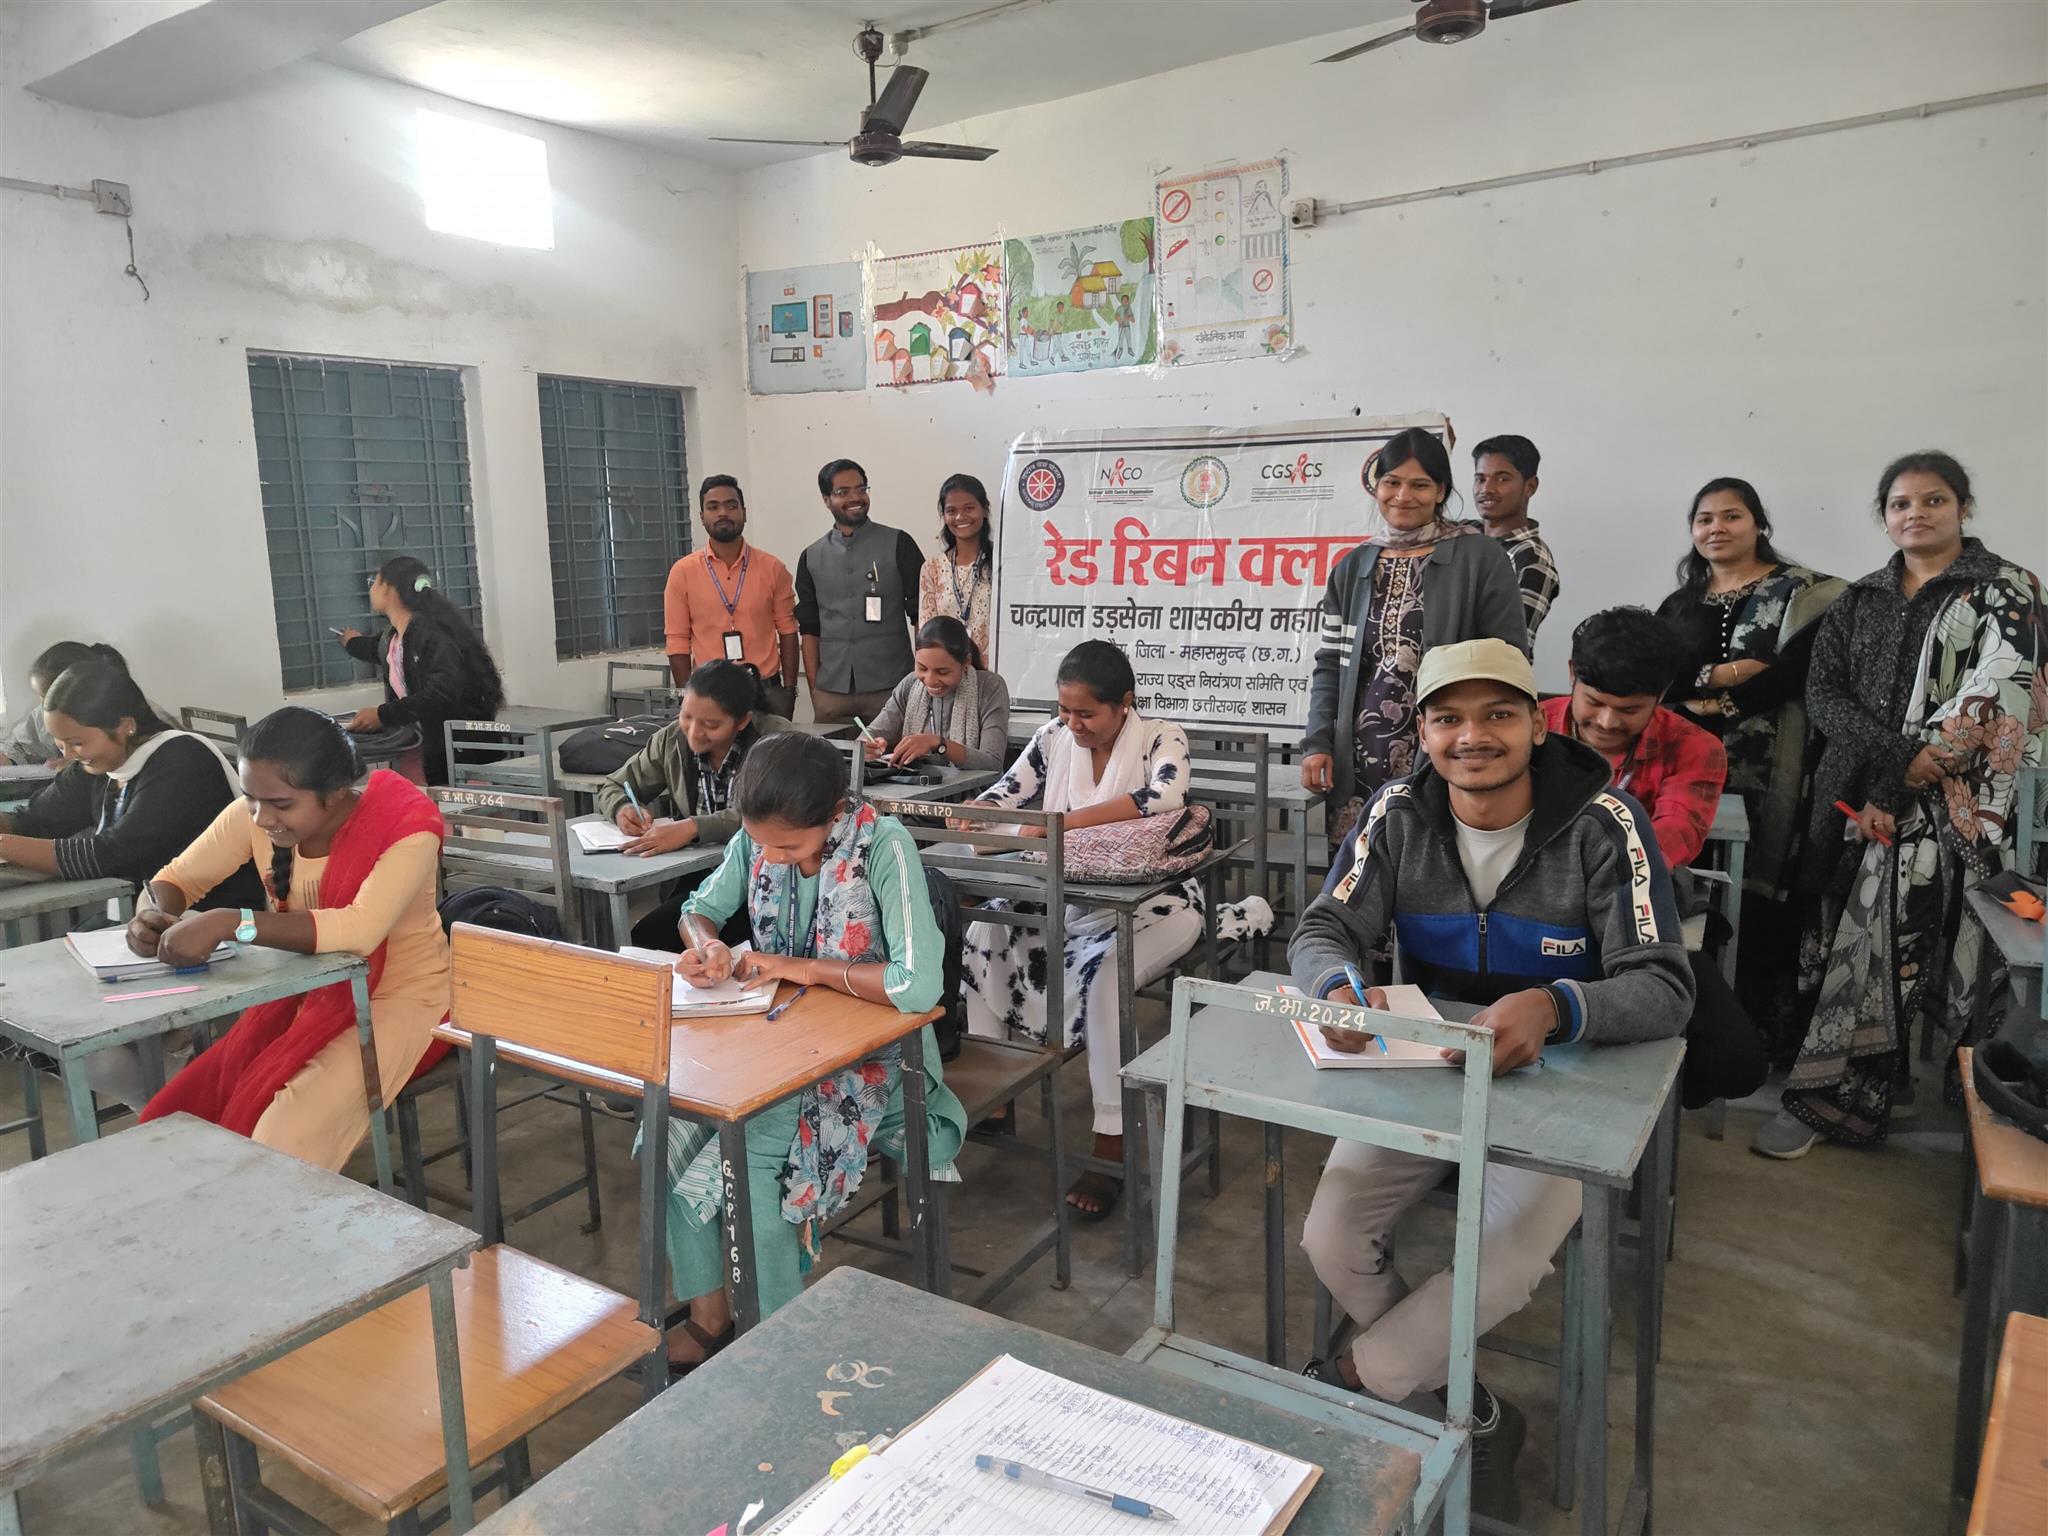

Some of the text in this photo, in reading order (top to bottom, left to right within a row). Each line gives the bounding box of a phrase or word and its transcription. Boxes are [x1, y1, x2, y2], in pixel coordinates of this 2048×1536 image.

[1101, 457, 1143, 487] NACO
[1043, 520, 1102, 586] रेड
[1110, 516, 1231, 586] रिबन
[1010, 604, 1086, 629] चन्द्रपाल
[1169, 598, 1264, 632] शासकीय
[1135, 639, 1166, 659] जिला
[1179, 645, 1247, 666] महासमुन्द
[1252, 646, 1301, 664] (छ.ग.)
[1136, 670, 1309, 694] राज्य एड्स नियंत्रण समिति एवं
[1154, 692, 1189, 711] विभाग
[1192, 694, 1247, 717] छत्तीसगढ़
[1251, 701, 1287, 716] शासन
[480, 794, 505, 807] 264
[1385, 785, 1411, 796] ILA
[1601, 797, 1633, 833] FILA
[1343, 857, 1364, 892] FILA
[1630, 847, 1648, 888] FILA
[1635, 904, 1655, 944] FILA
[1543, 941, 1585, 955] FILA
